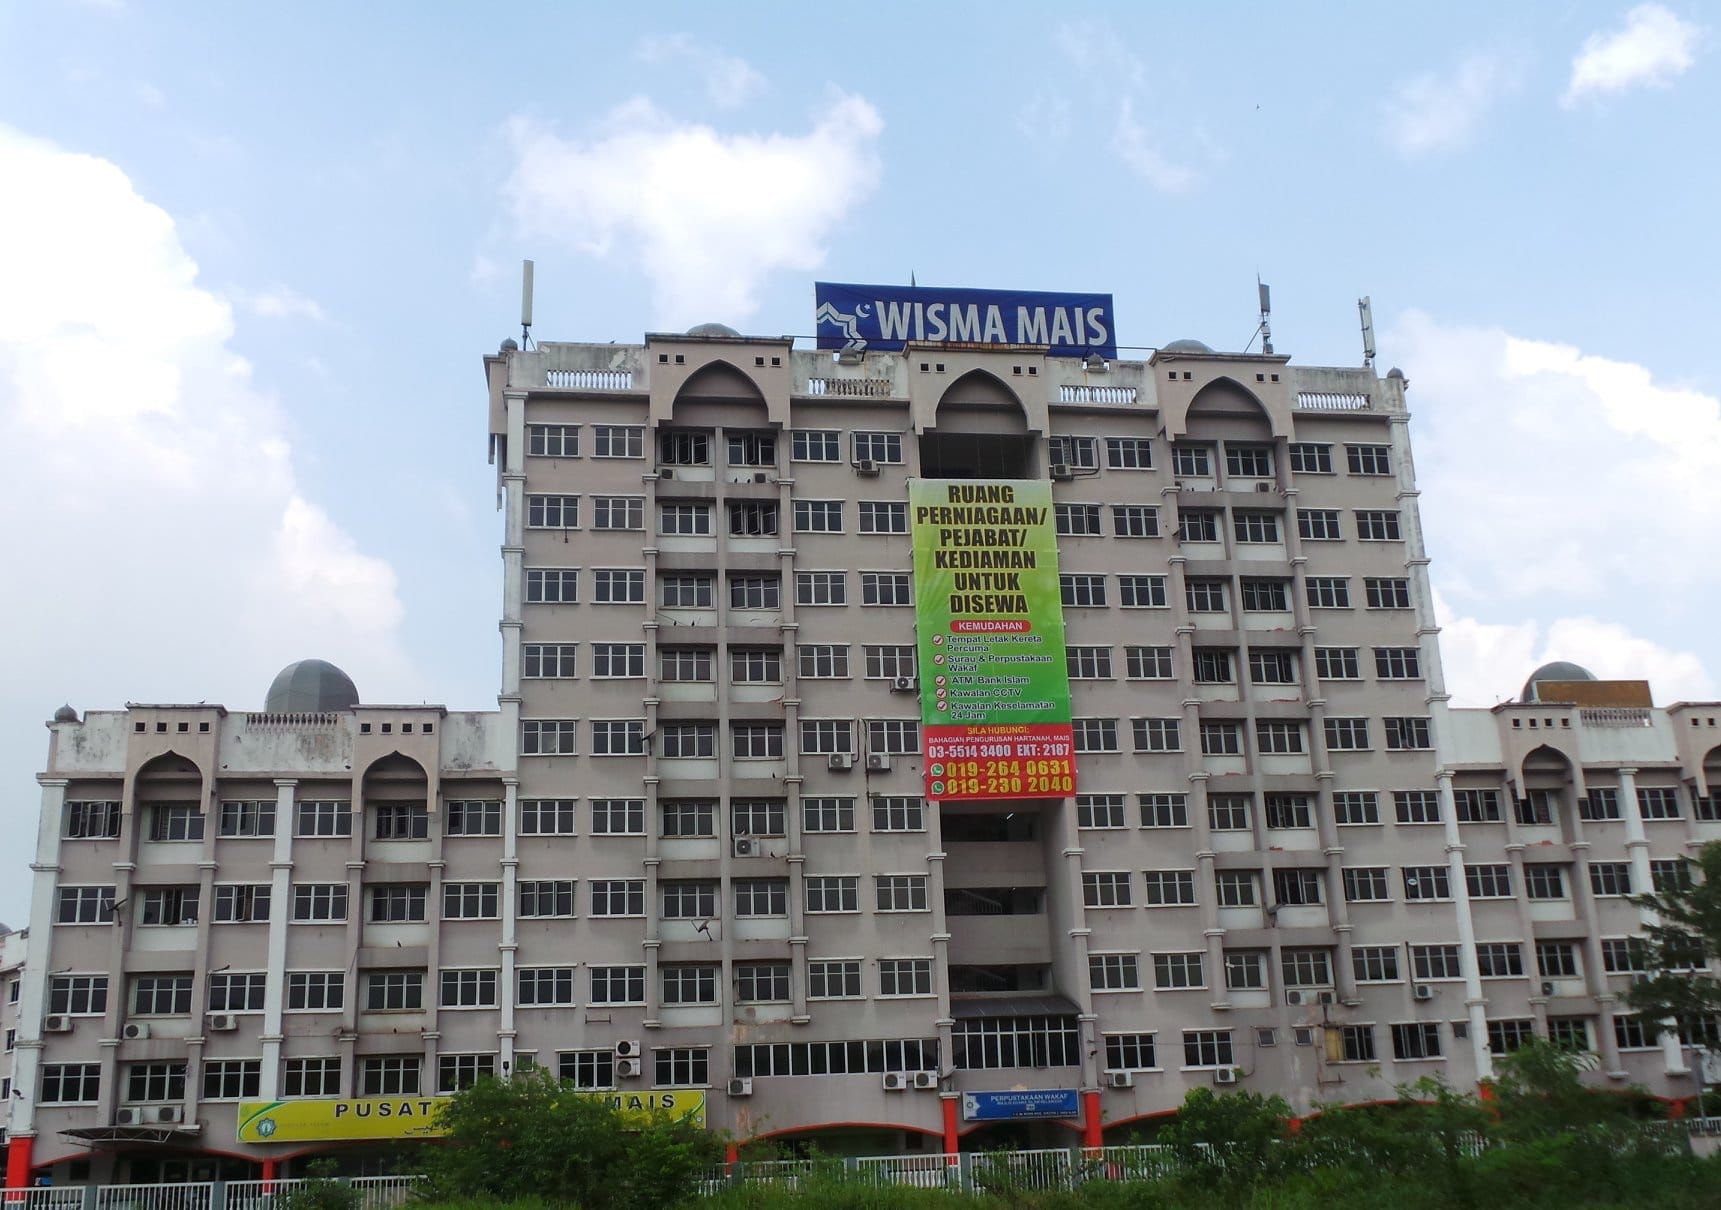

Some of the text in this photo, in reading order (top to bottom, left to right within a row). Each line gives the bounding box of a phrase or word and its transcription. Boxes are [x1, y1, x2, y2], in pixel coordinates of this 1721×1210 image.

[875, 301, 1108, 346] WISMA MAIS
[948, 485, 1014, 503] RUANG
[917, 507, 1047, 525] PERNIAGAAN/
[940, 529, 1027, 547] PEJABAT/
[935, 551, 1036, 569] KEDIAMAN
[955, 573, 1020, 591] UNTUK
[950, 595, 1028, 613] DISEWA
[958, 622, 1023, 630] KEMUDAHAN
[947, 635, 981, 644] Tempat
[983, 635, 1009, 643] Letak
[948, 655, 976, 663] Surau
[988, 655, 1053, 663] Perpustakaan
[949, 664, 978, 672] Wakaf
[977, 676, 1002, 684] Bank
[1004, 676, 1030, 684] Islam
[950, 689, 991, 697] Kawalan
[951, 702, 1055, 711] Kawalan Keselamatan
[951, 711, 986, 719] 24 Jam
[967, 726, 1030, 735] SILA HUBUNGI:
[928, 736, 965, 744] BAHAGIAN
[1053, 734, 1070, 742] MAIS
[928, 745, 978, 758] 03-5514
[980, 744, 1012, 757] 3400
[1043, 743, 1070, 756] 2187
[946, 760, 1071, 777] 019-264 0631
[947, 776, 1073, 794] 019-230 2040
[335, 1101, 432, 1117] PUSAT
